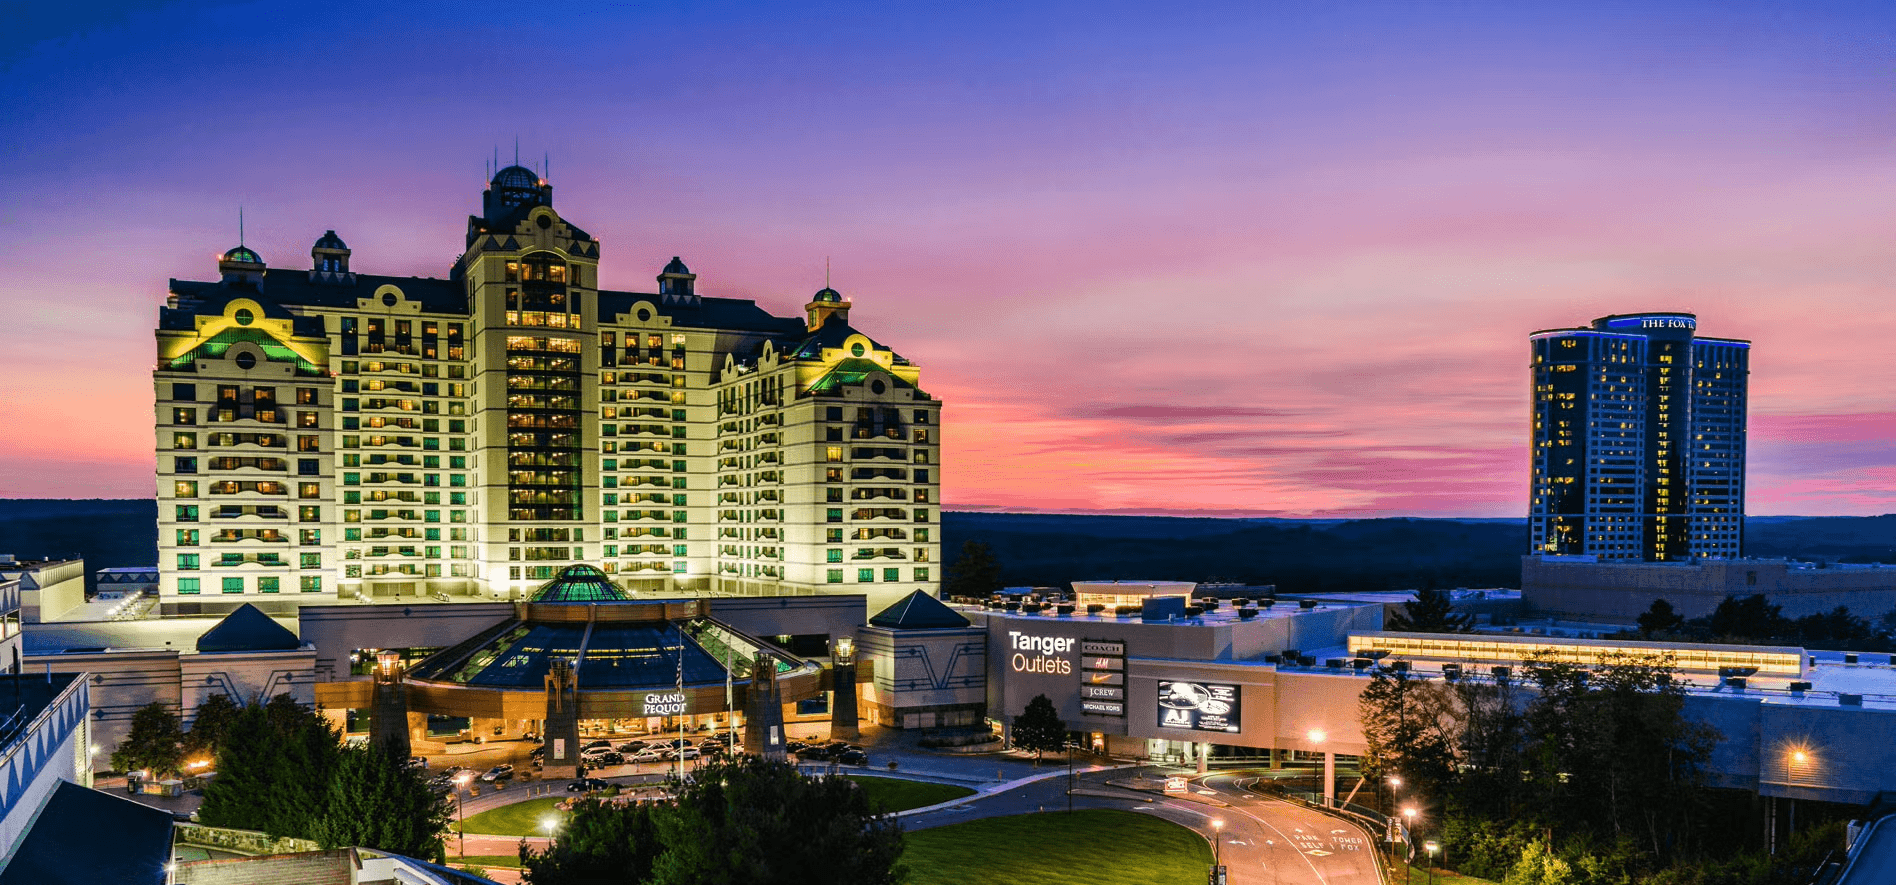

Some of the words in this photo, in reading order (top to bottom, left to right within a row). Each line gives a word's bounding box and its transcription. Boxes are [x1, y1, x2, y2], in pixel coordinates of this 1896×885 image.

[1642, 319, 1664, 328] THE
[1668, 319, 1686, 328] FOX
[1009, 631, 1075, 655] Tanger
[1012, 653, 1071, 674] Outlets
[646, 694, 685, 703] GRAND
[644, 703, 687, 714] PEQUOT
[1083, 703, 1105, 711] MICHAEL
[1332, 836, 1362, 844] TOWER
